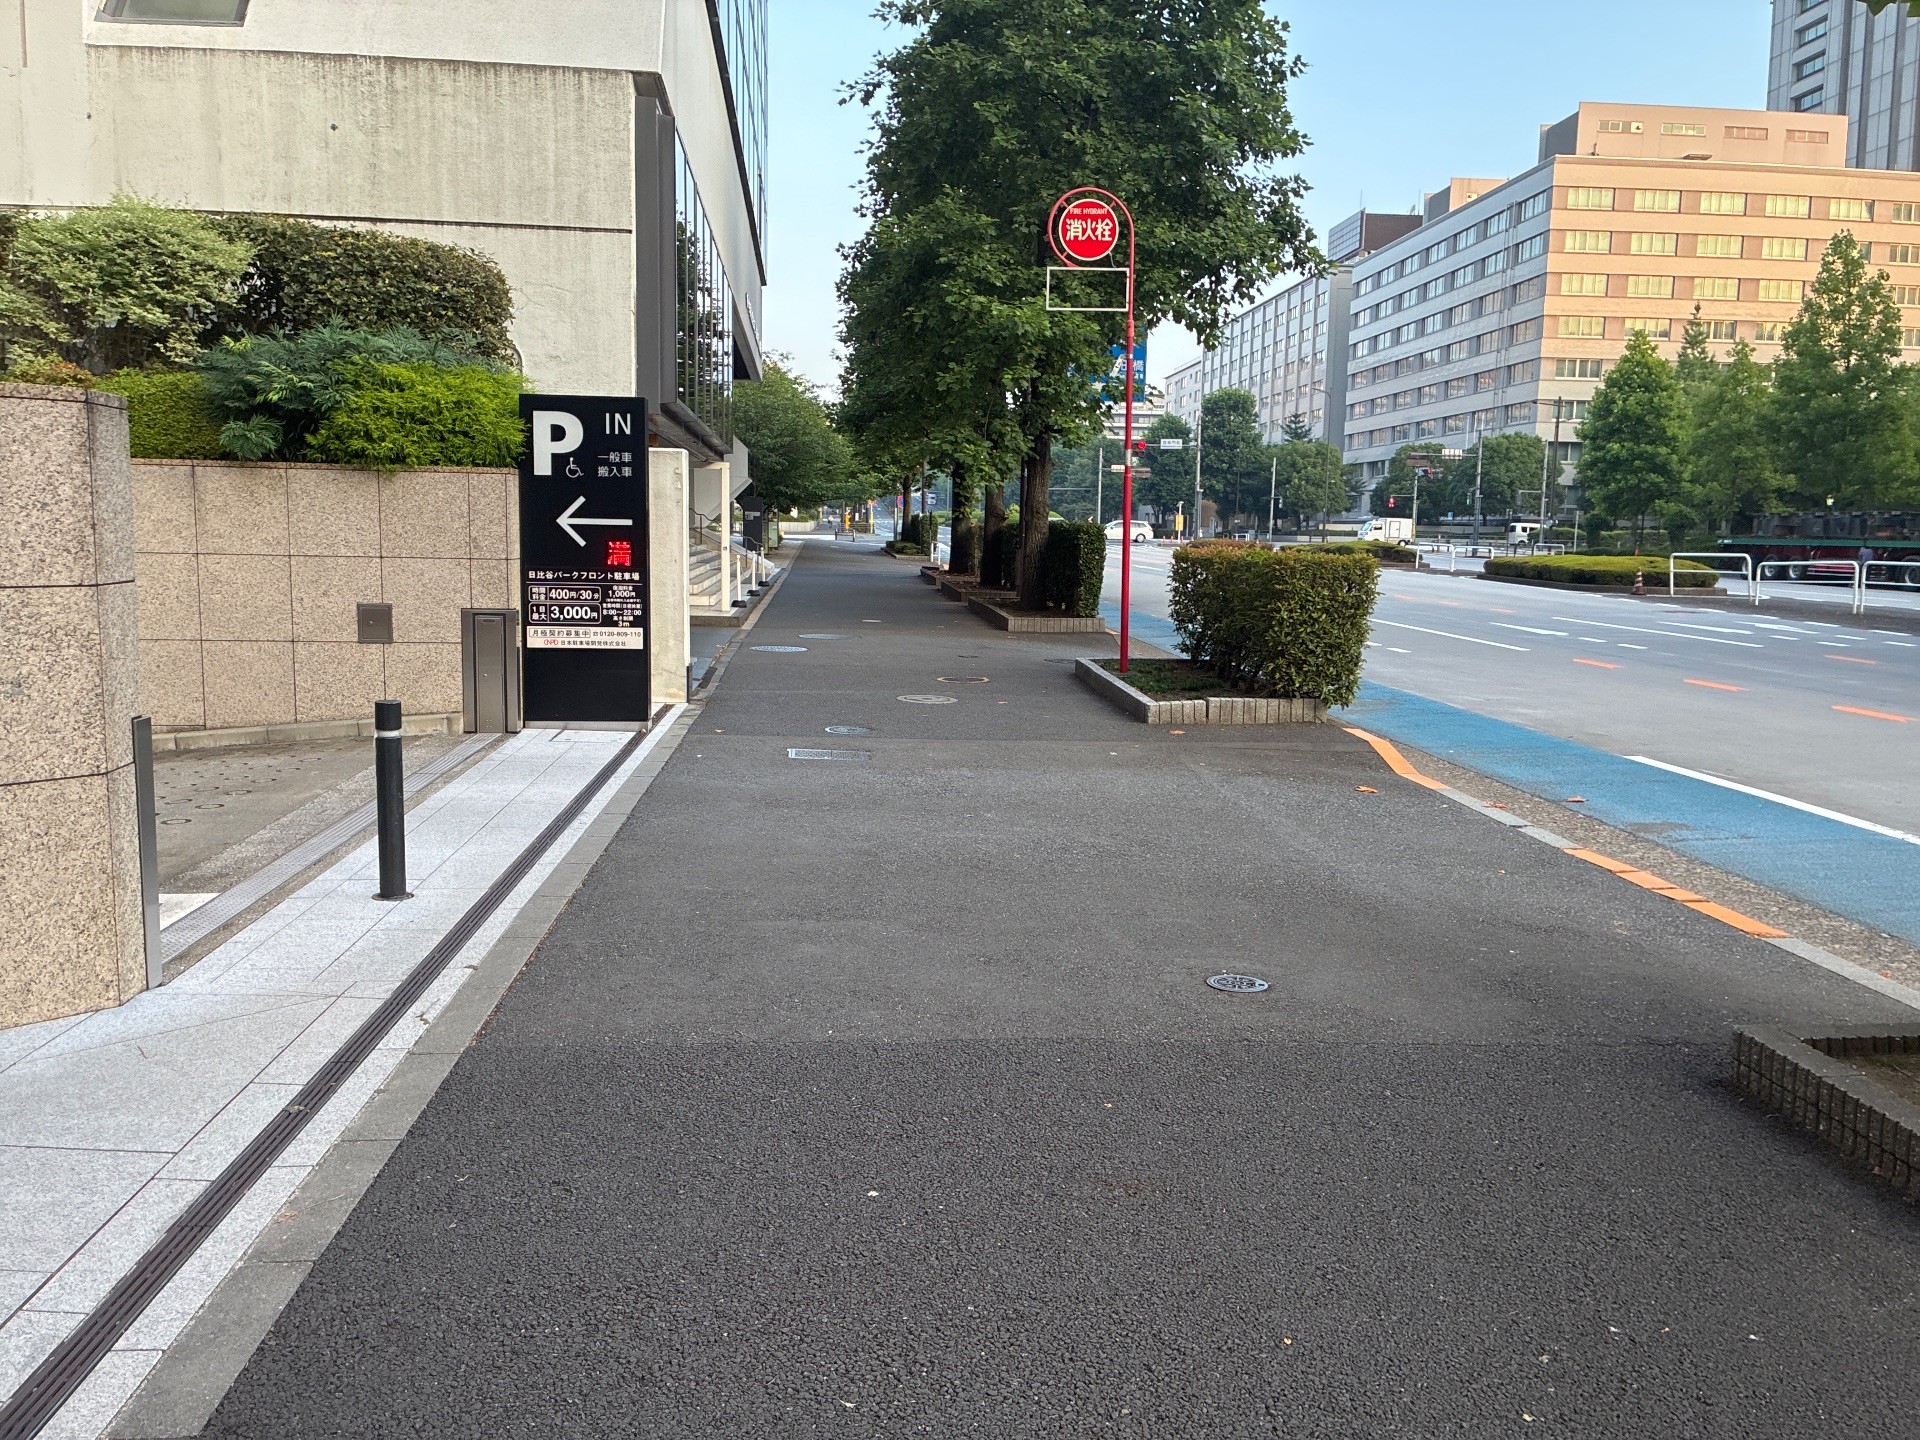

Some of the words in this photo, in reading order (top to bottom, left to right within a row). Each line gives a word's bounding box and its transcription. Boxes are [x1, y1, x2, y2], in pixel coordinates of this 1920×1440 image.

[1066, 218, 1113, 242] 消火栓
[605, 412, 631, 435] IN
[532, 410, 584, 476] P
[597, 452, 633, 463] 一般車
[597, 466, 633, 477] 搬入車
[608, 541, 632, 566] 満
[528, 571, 640, 581] 日比谷パークフロント駐車場
[549, 589, 600, 600] 400円/30分
[608, 590, 636, 598] 1,000円
[550, 605, 598, 620] 3,000円
[532, 629, 590, 637] 月極契約募集中
